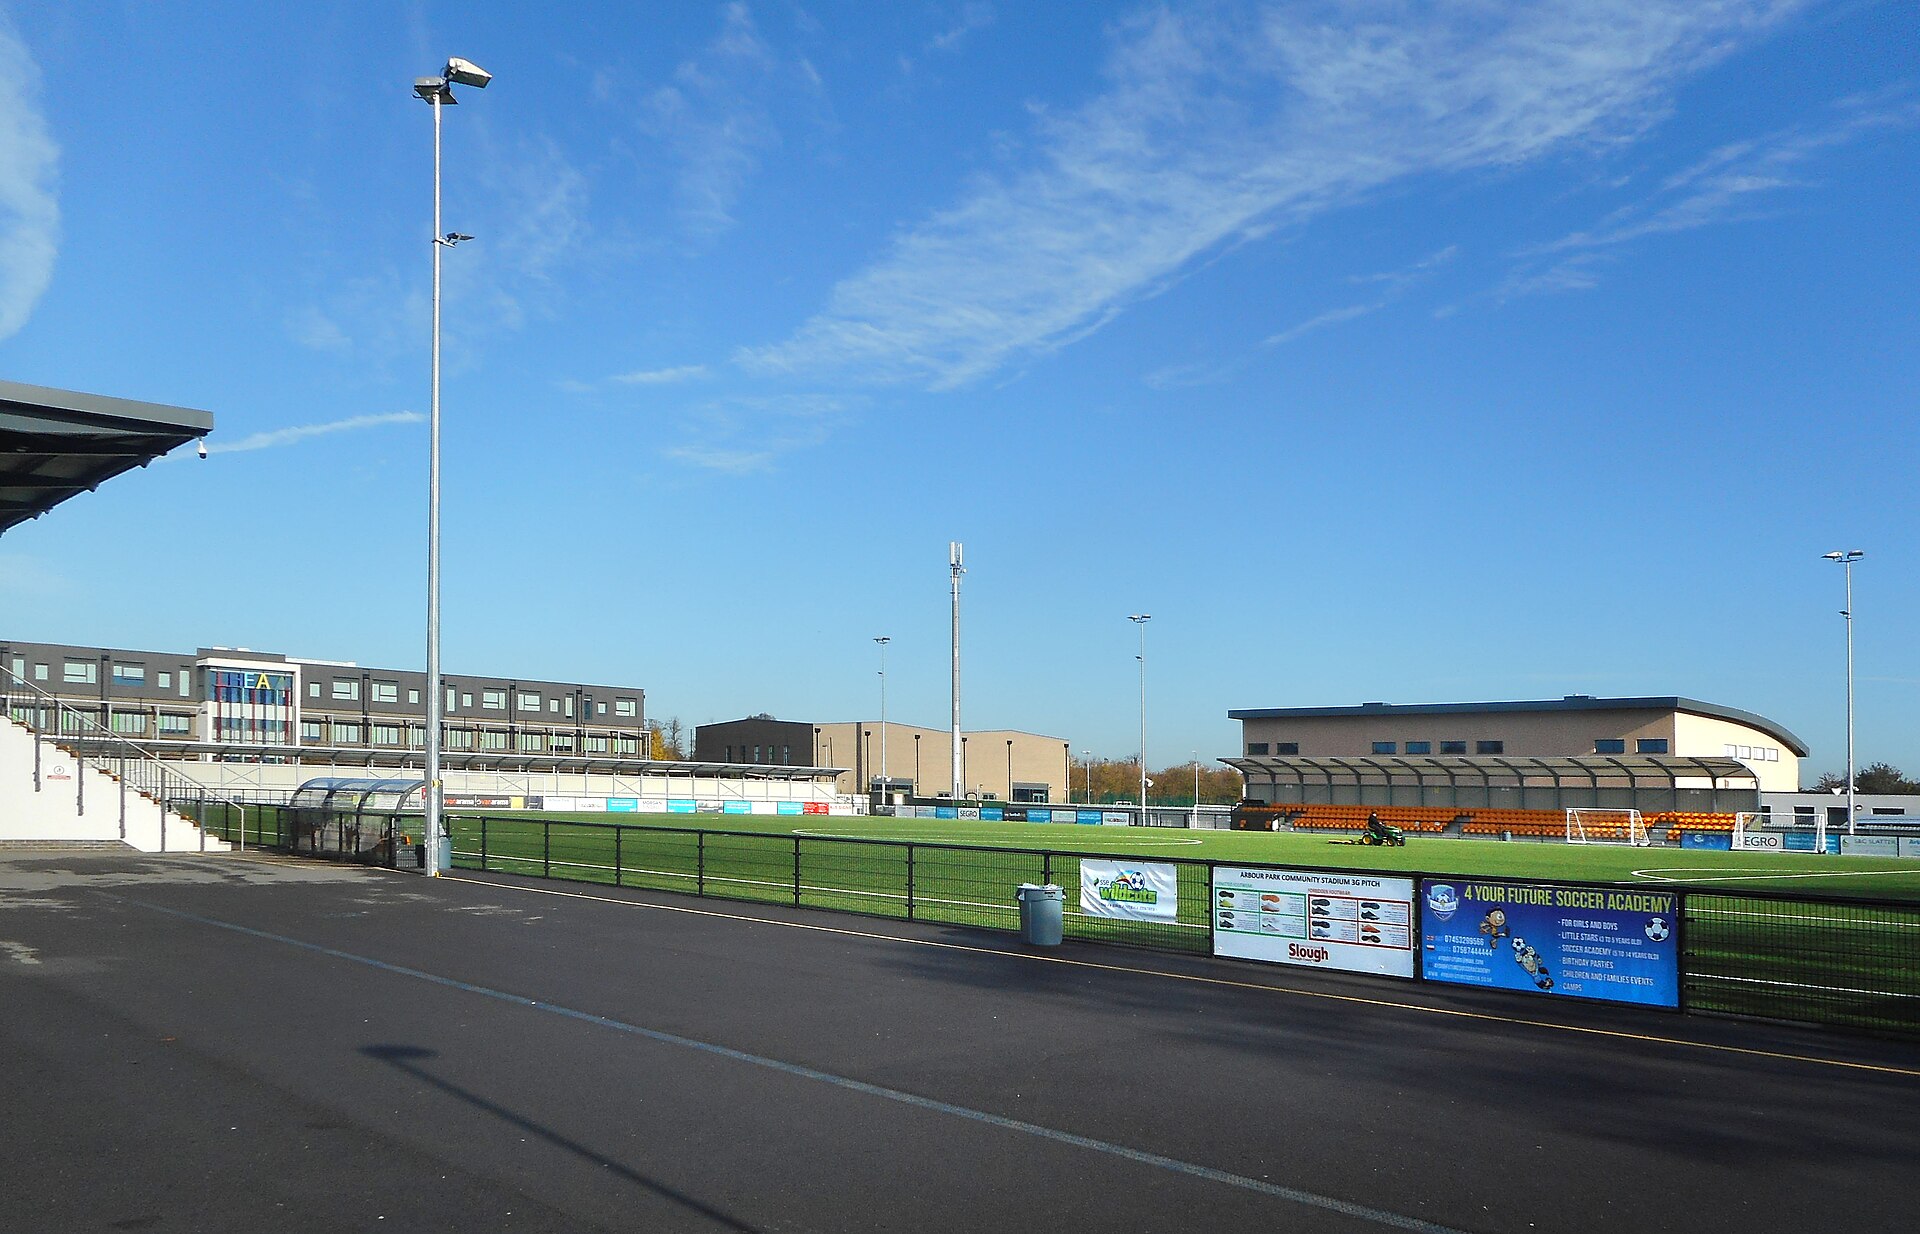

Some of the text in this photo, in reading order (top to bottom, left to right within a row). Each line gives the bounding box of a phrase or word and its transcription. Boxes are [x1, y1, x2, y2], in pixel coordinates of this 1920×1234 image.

[959, 810, 978, 818] SEGRO
[1744, 836, 1778, 847] EGRO
[1240, 872, 1264, 880] ARBOUR
[1281, 875, 1320, 883] COMMUNITY
[1321, 877, 1350, 885] STADIUM
[1100, 882, 1157, 903] wildcats
[1464, 885, 1671, 913] 4 YOUR FUTURE SOCCER ACADEMY
[1562, 919, 1618, 930] FOR GIRLS AND BOYS
[1562, 931, 1579, 940] LITTLE
[1580, 933, 1598, 942] STARS
[1289, 943, 1329, 962] Slough
[1562, 945, 1583, 953] SOCCER
[1584, 946, 1611, 956] ACADEMY
[1562, 957, 1614, 969] BIRTHDAY PARTIES
[1562, 970, 1654, 986] CHILDREN AND FAMILIES EVENTS
[1563, 984, 1583, 992] CAMPS
